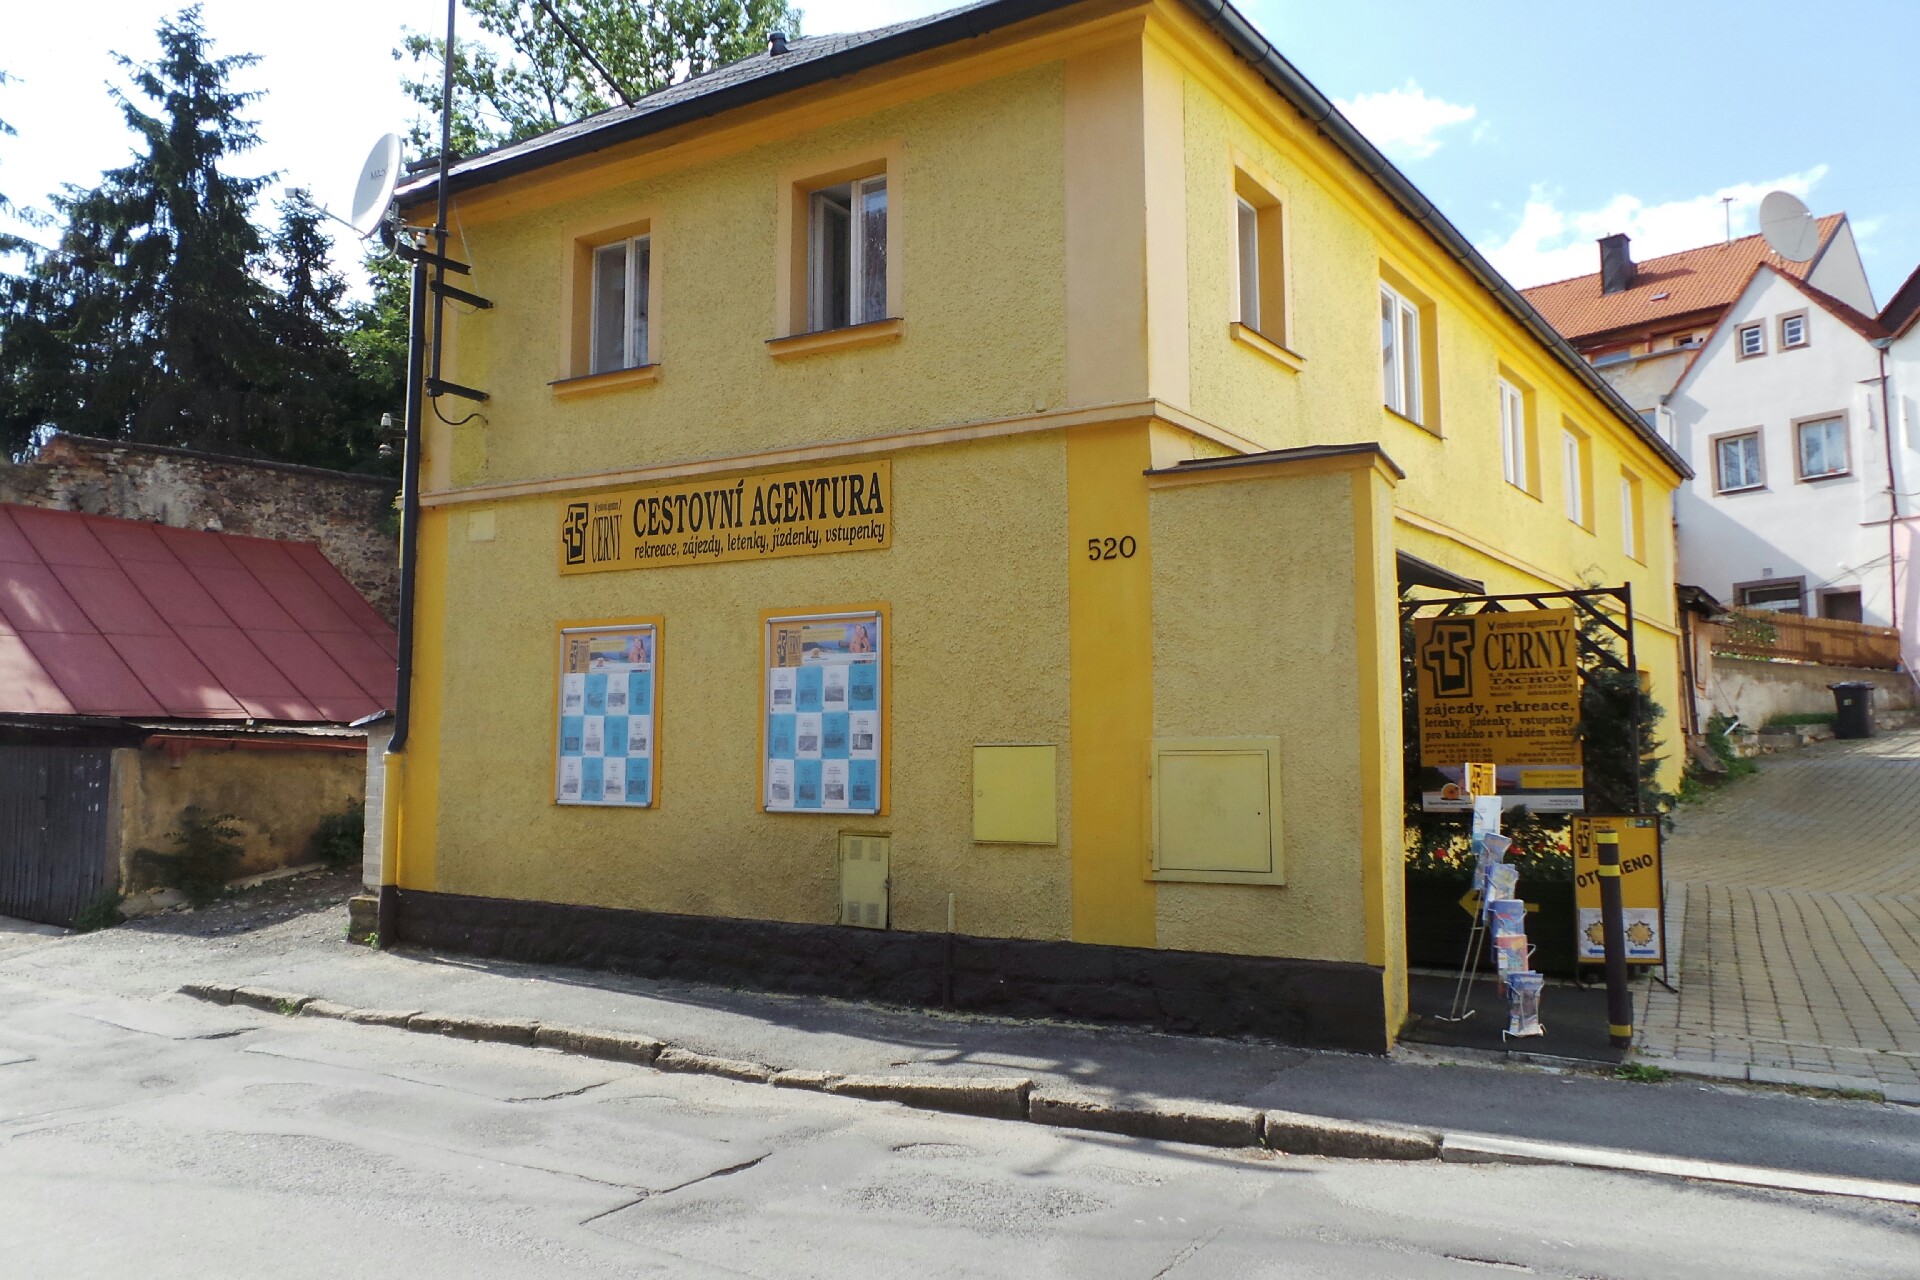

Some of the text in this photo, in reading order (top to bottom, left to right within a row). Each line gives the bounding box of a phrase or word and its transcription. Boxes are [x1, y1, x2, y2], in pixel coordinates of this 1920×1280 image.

[633, 472, 884, 537] CESTOVNÍ AGENTURA
[634, 519, 885, 560] rekreace, zájezdy, letenky, jízdenky, vstupenky
[1088, 535, 1136, 561] 520
[1490, 675, 1571, 684] TACHOV
[1425, 700, 1575, 718] zájezdy, rekreace,
[1426, 732, 1441, 741] pro
[1577, 854, 1653, 888] OTENO
